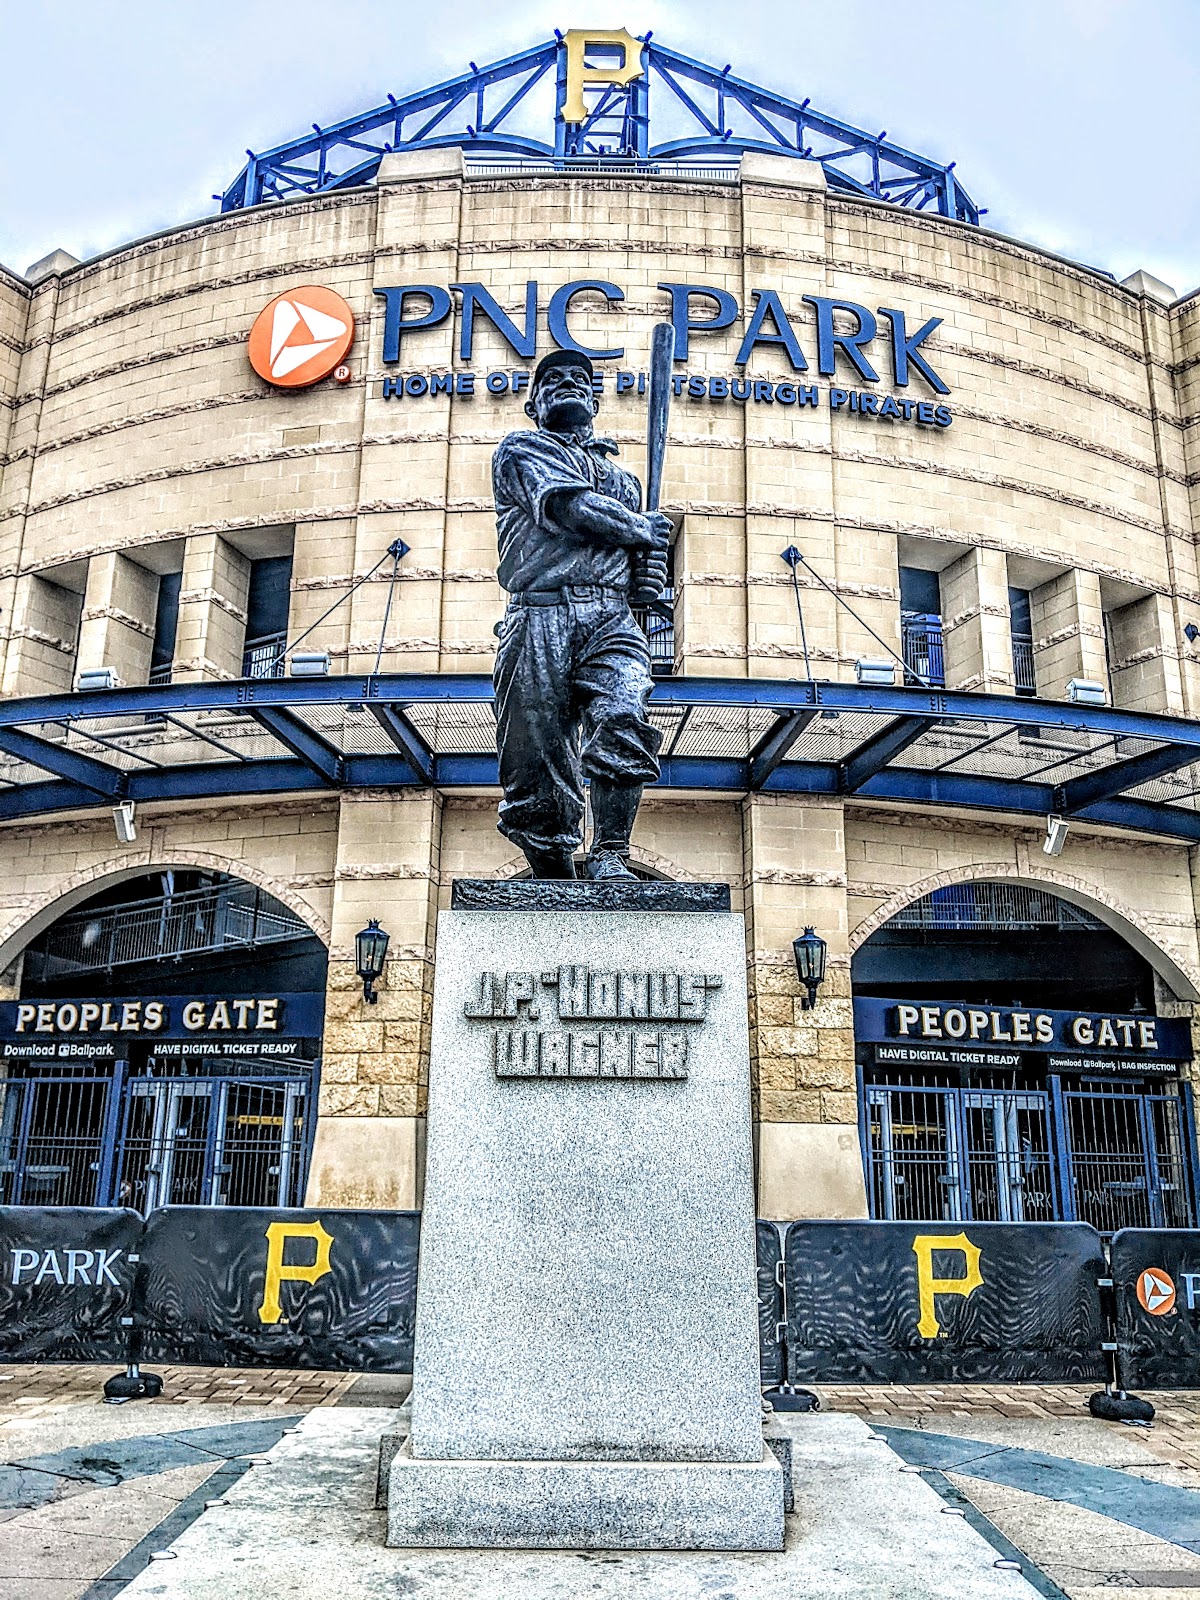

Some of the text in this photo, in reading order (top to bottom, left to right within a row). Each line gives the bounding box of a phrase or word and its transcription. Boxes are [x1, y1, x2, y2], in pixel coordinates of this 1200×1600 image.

[560, 27, 645, 123] P
[373, 279, 951, 395] PNC PARK
[382, 373, 475, 399] HOME
[486, 371, 530, 394] OF
[616, 371, 819, 408] PITSBURGH
[830, 388, 953, 427] PIRATES
[15, 998, 279, 1032] PEOPLES GATE
[464, 971, 540, 1020] J.P.
[3, 1043, 56, 1056] Download
[154, 1043, 298, 1054] HAVE DIGITAL TICKET READY
[896, 1004, 1159, 1050] PEOPLES GATE
[495, 1030, 689, 1080] WAGNER
[879, 1048, 1020, 1065] HAVE DIGITAL TICKET READY
[1050, 1058, 1082, 1068] Download
[1121, 1061, 1137, 1070] BAG
[1137, 1063, 1177, 1072] INSPECTION
[10, 1248, 123, 1287] PARK
[258, 1219, 334, 1325] P
[912, 1231, 985, 1339] P
